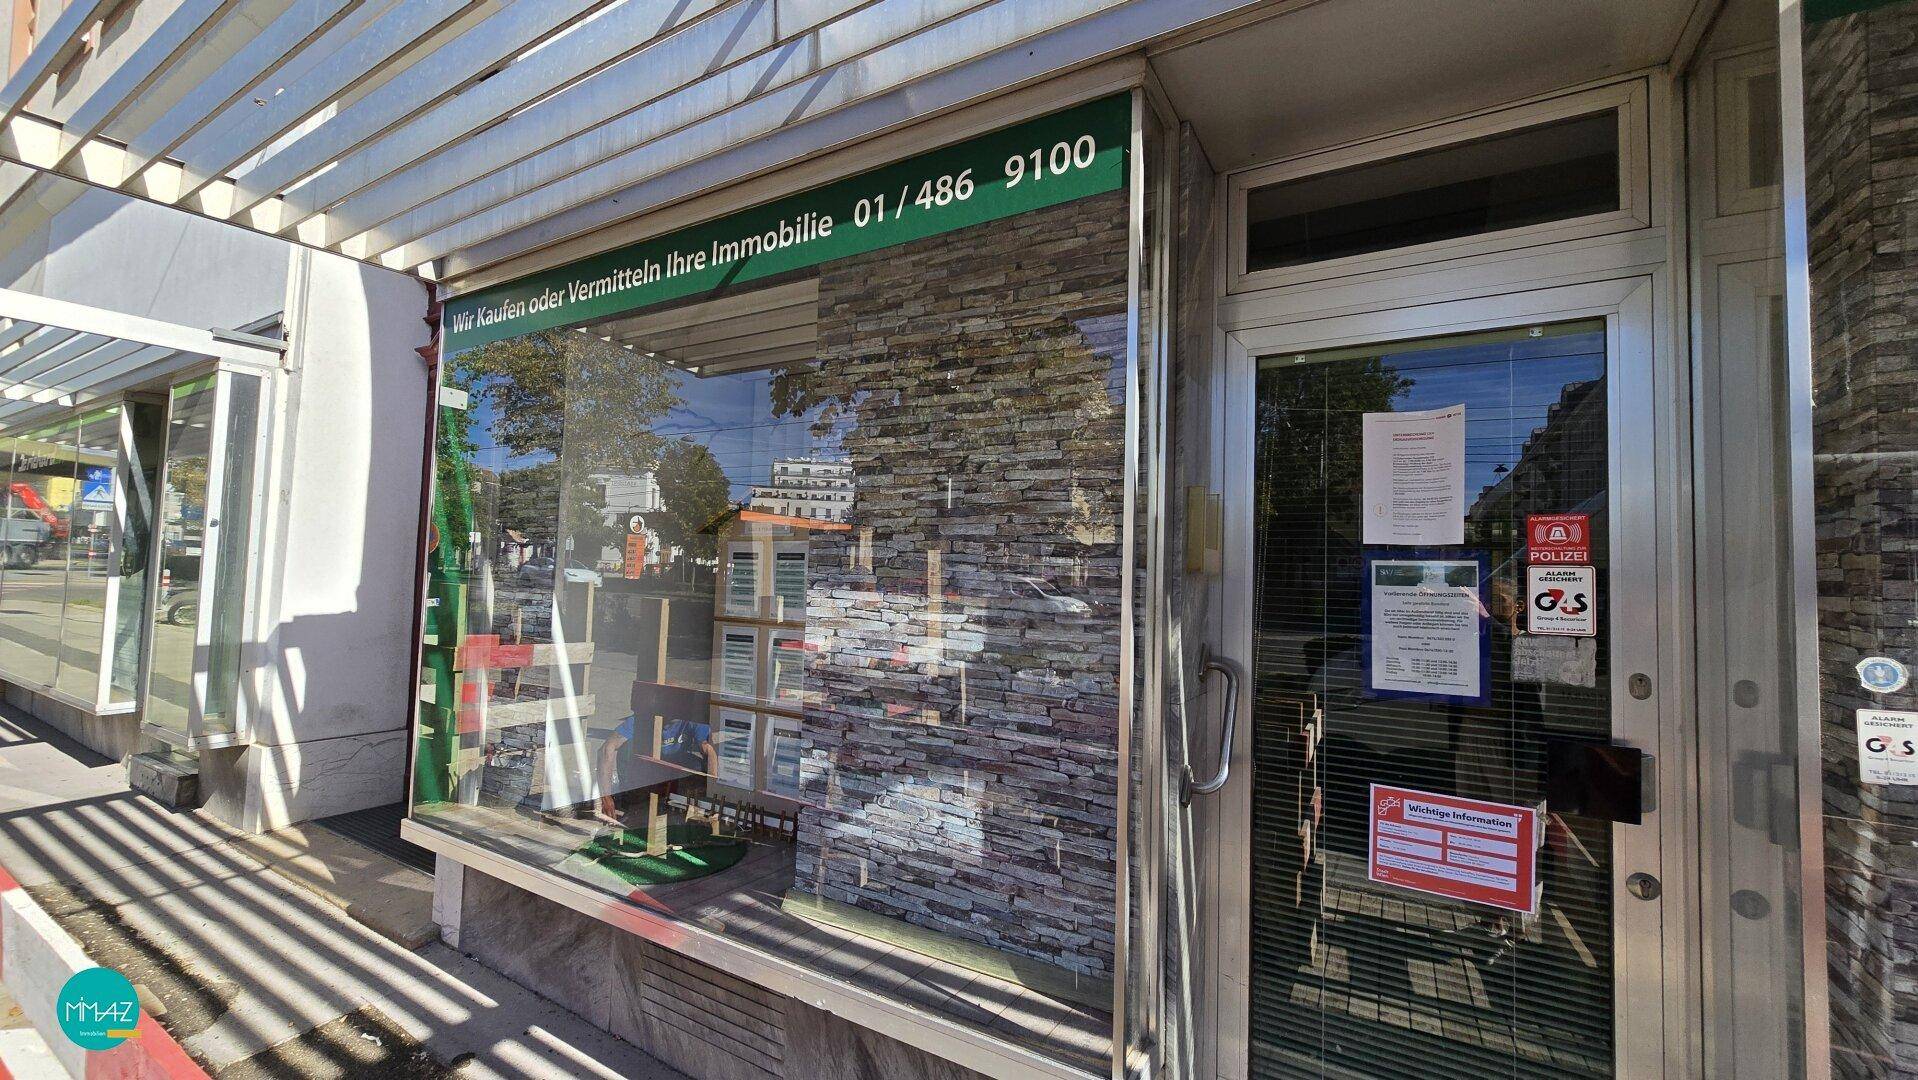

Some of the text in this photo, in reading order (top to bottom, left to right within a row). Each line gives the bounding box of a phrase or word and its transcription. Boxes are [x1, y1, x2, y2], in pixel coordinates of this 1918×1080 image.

[453, 135, 1096, 333] Wir Kaufen oder Vermitteln Ihre Immobilie 01 / 486 9100
[1530, 551, 1587, 562] POLIZEI
[1535, 588, 1588, 615] G4S
[1864, 721, 1915, 729] GESICHERT
[1872, 715, 1906, 723] ALARM
[1408, 803, 1451, 820] Wichtige
[1452, 811, 1513, 828] Information
